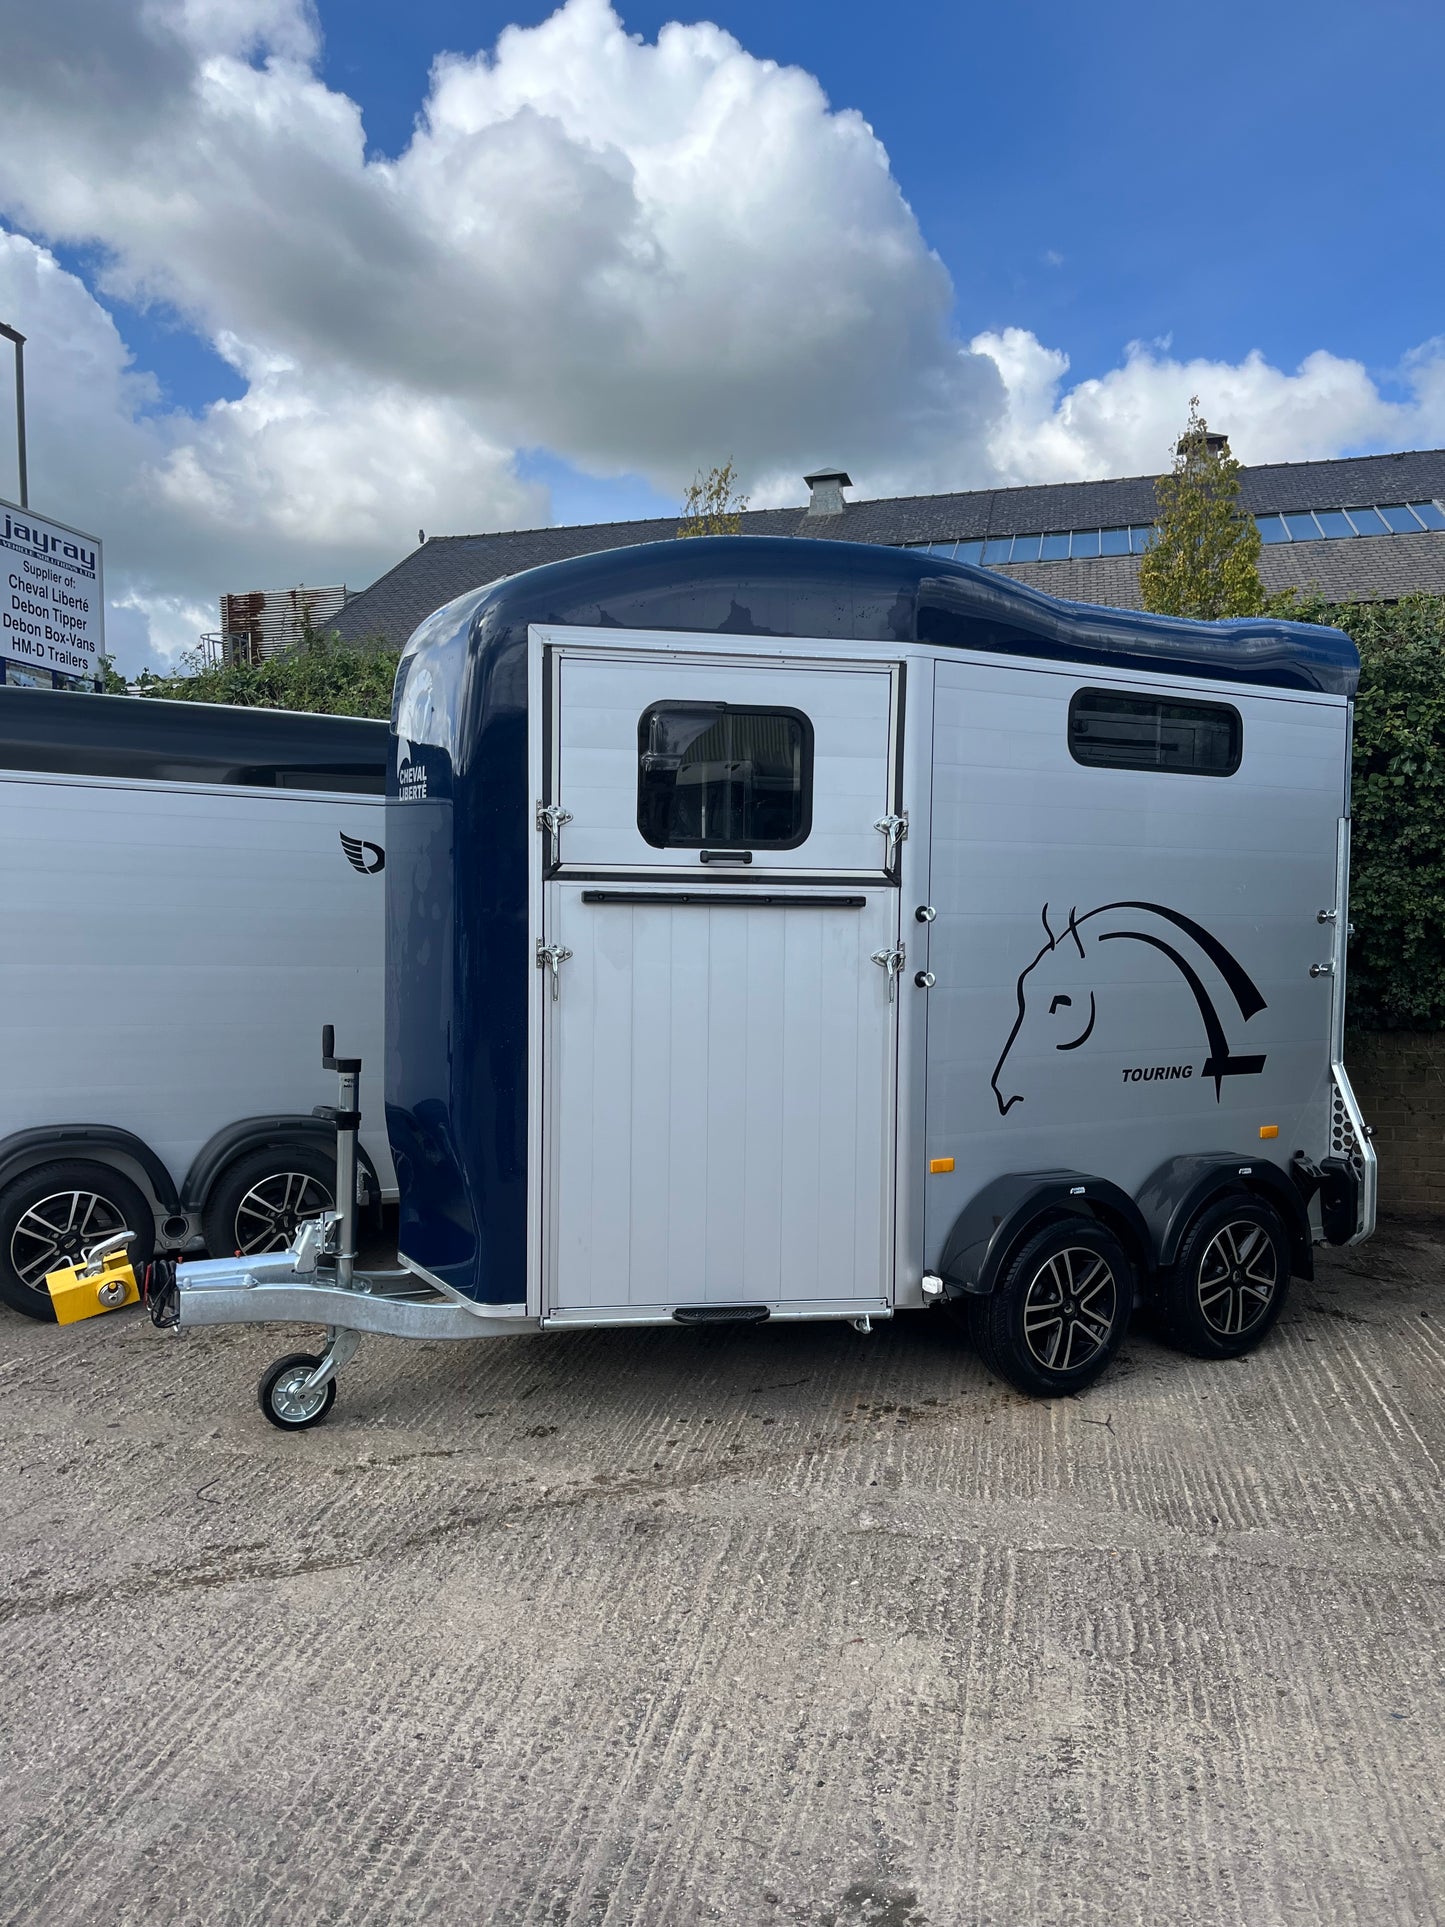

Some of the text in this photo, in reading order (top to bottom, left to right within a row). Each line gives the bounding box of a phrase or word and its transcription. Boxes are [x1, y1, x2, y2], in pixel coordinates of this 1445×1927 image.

[0, 514, 95, 571] jayray
[23, 560, 76, 589] Supplier of:
[8, 574, 89, 612] Cheval Liberté
[11, 595, 87, 631] Debon Tipper
[3, 613, 95, 653] Debon Box-Vans
[12, 636, 89, 670] HM-D Trailers
[399, 781, 427, 801] LIBERTÉ
[400, 765, 427, 785] CHEVAL
[1122, 1065, 1193, 1083] TOURING
